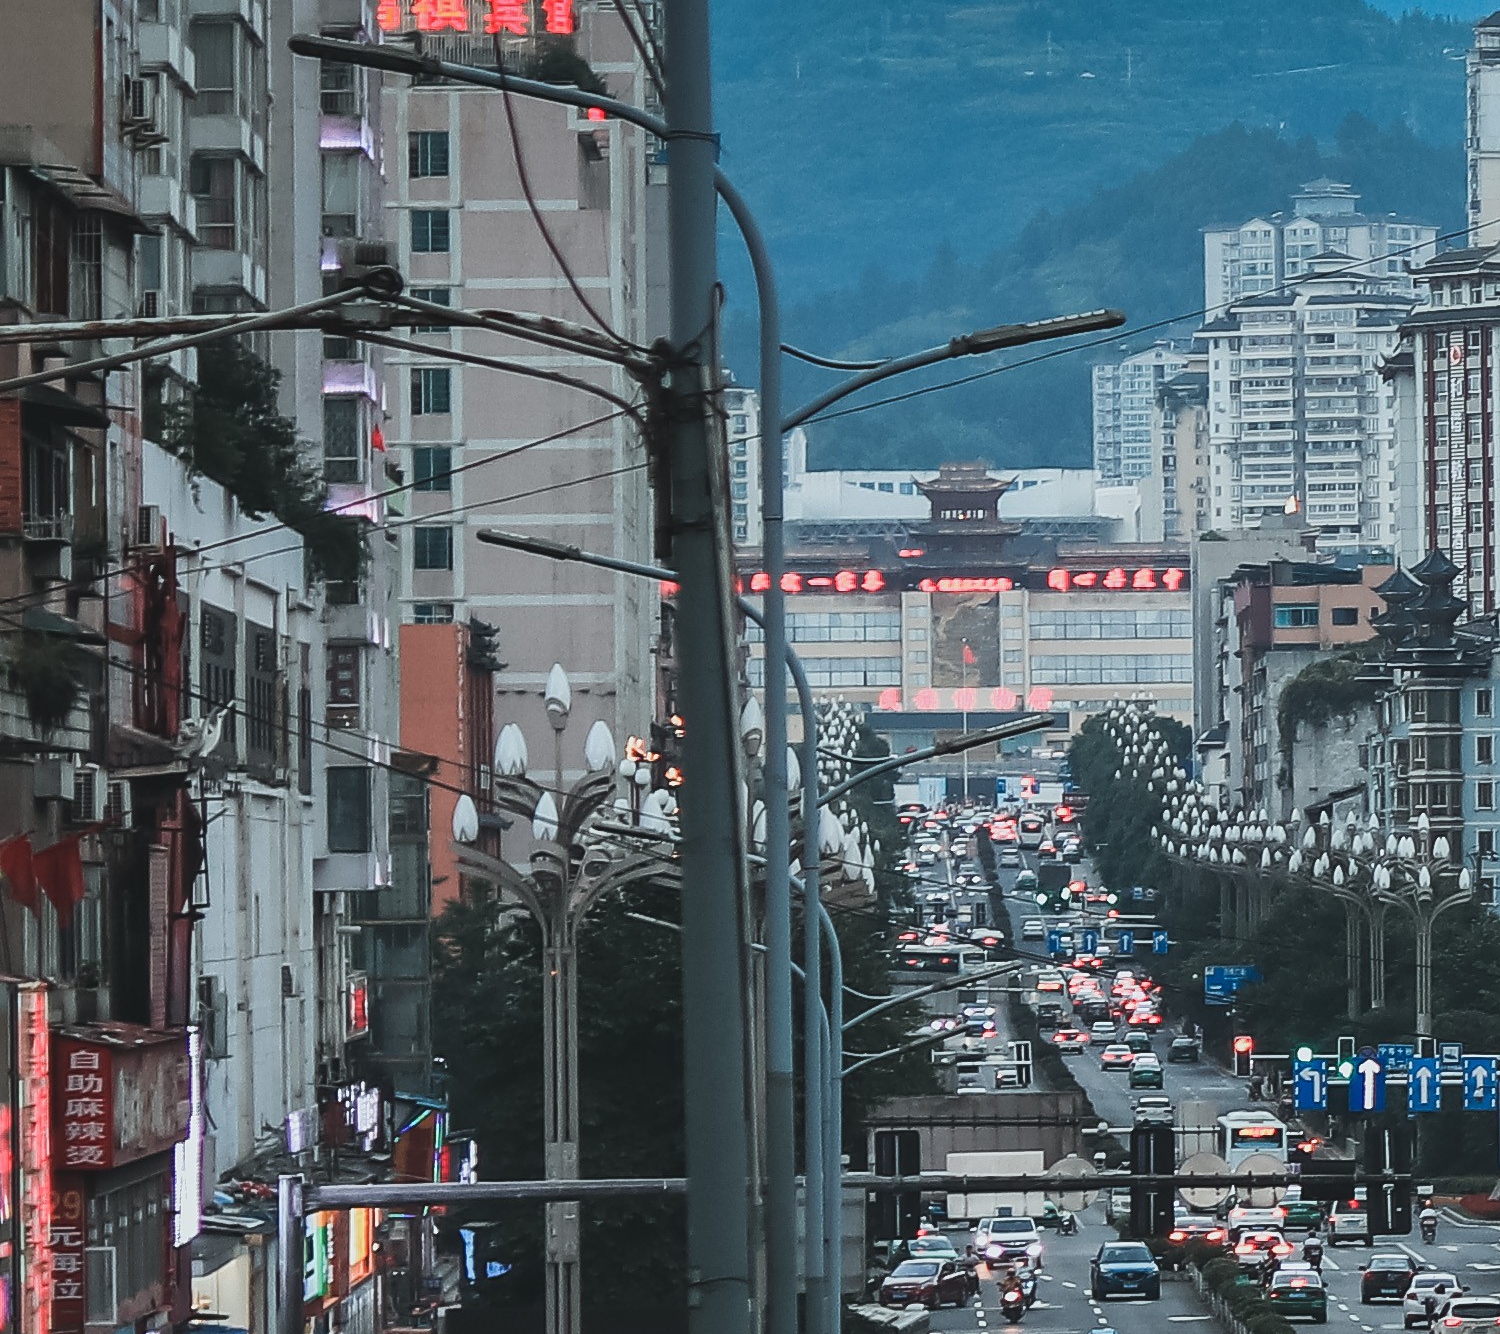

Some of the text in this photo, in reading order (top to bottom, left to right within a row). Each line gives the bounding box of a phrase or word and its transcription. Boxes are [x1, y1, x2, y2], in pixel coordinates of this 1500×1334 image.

[65, 1049, 105, 1165] 自助麻辣烫
